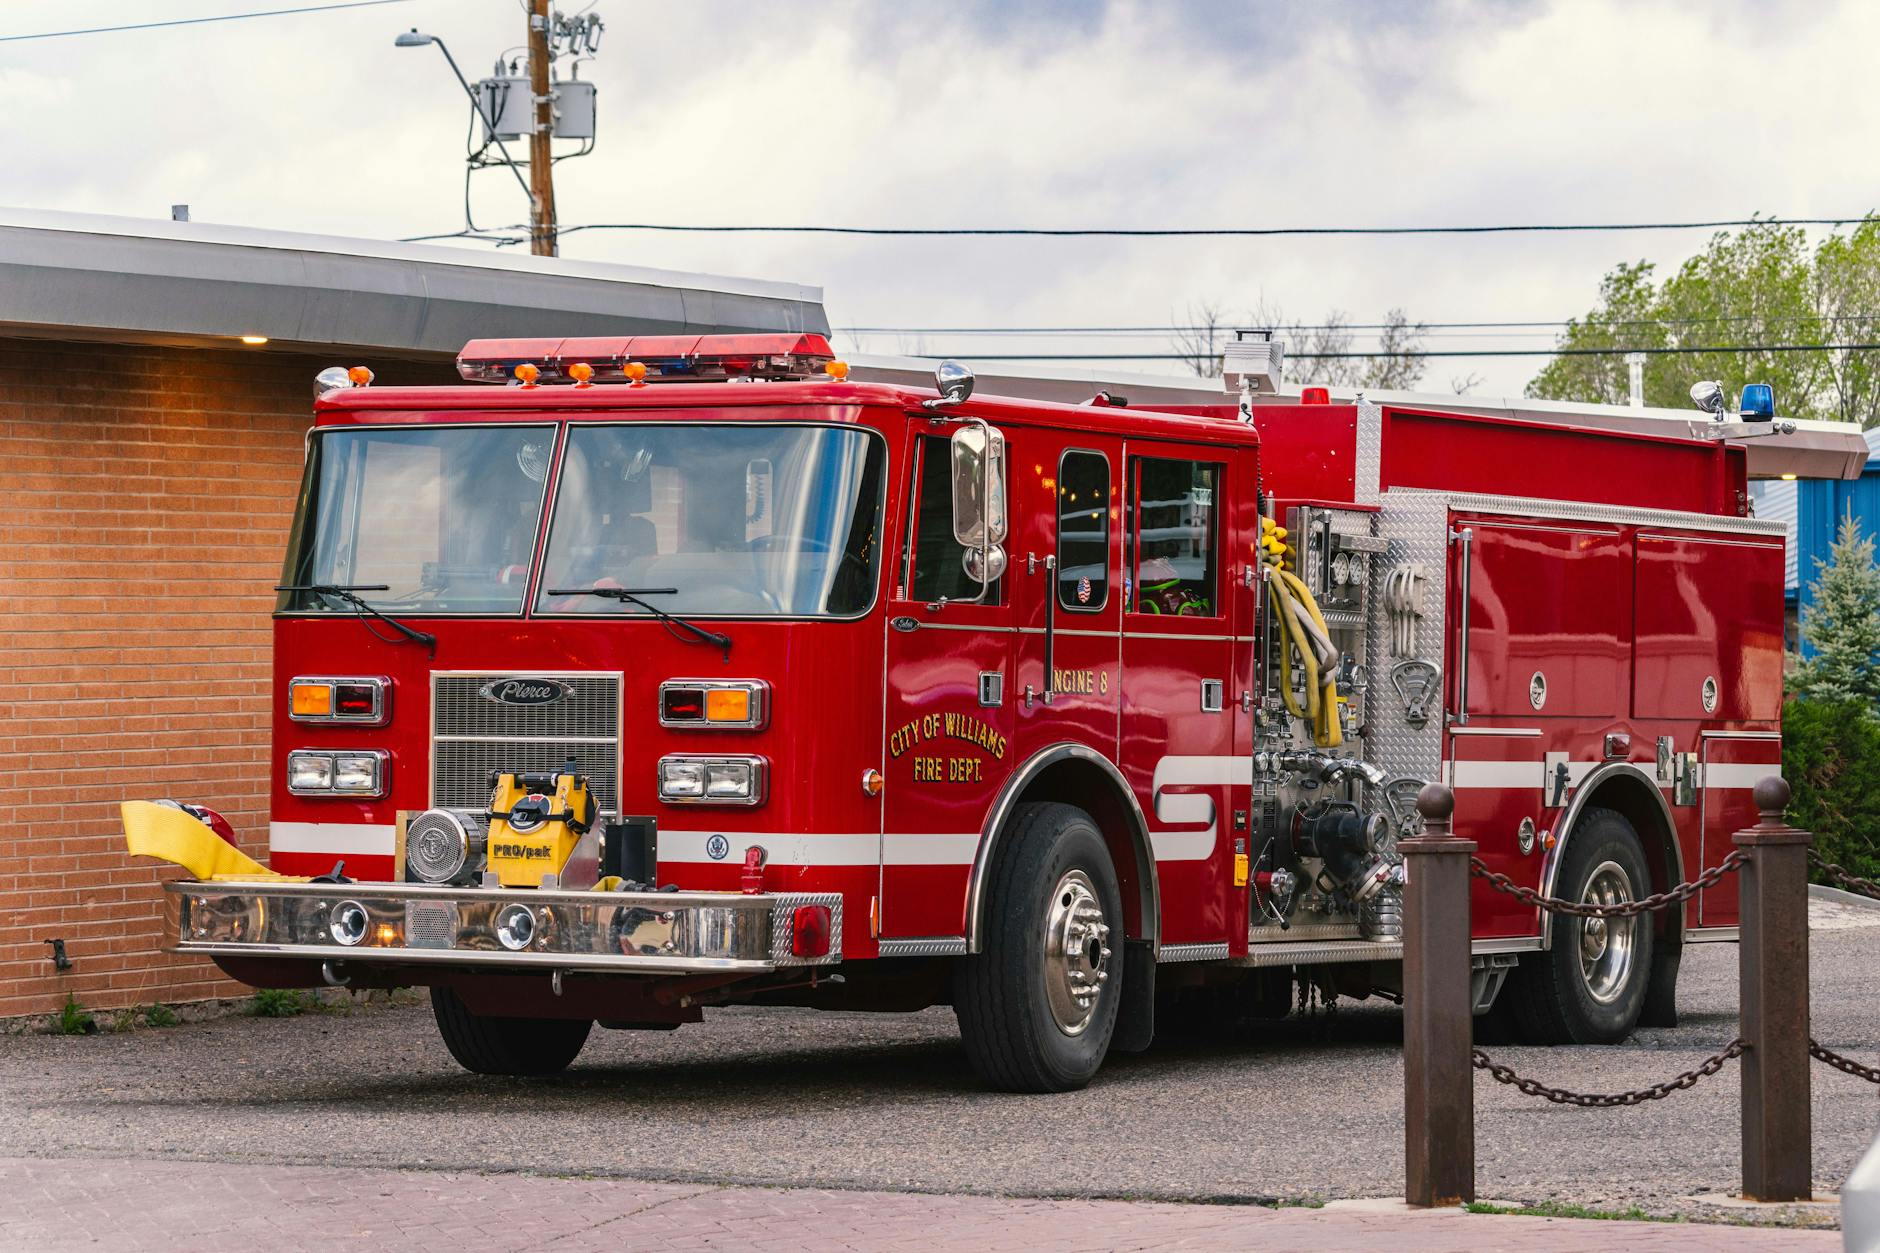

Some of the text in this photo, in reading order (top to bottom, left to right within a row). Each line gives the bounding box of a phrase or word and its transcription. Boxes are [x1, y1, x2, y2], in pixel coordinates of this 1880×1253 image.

[500, 681, 551, 701] Pierce
[1053, 669, 1108, 695] NGINE 8
[890, 712, 1007, 760] CITY OF WILLIAMS
[914, 757, 983, 781] FIRE DEPT.
[493, 844, 552, 860] PRO/pak
